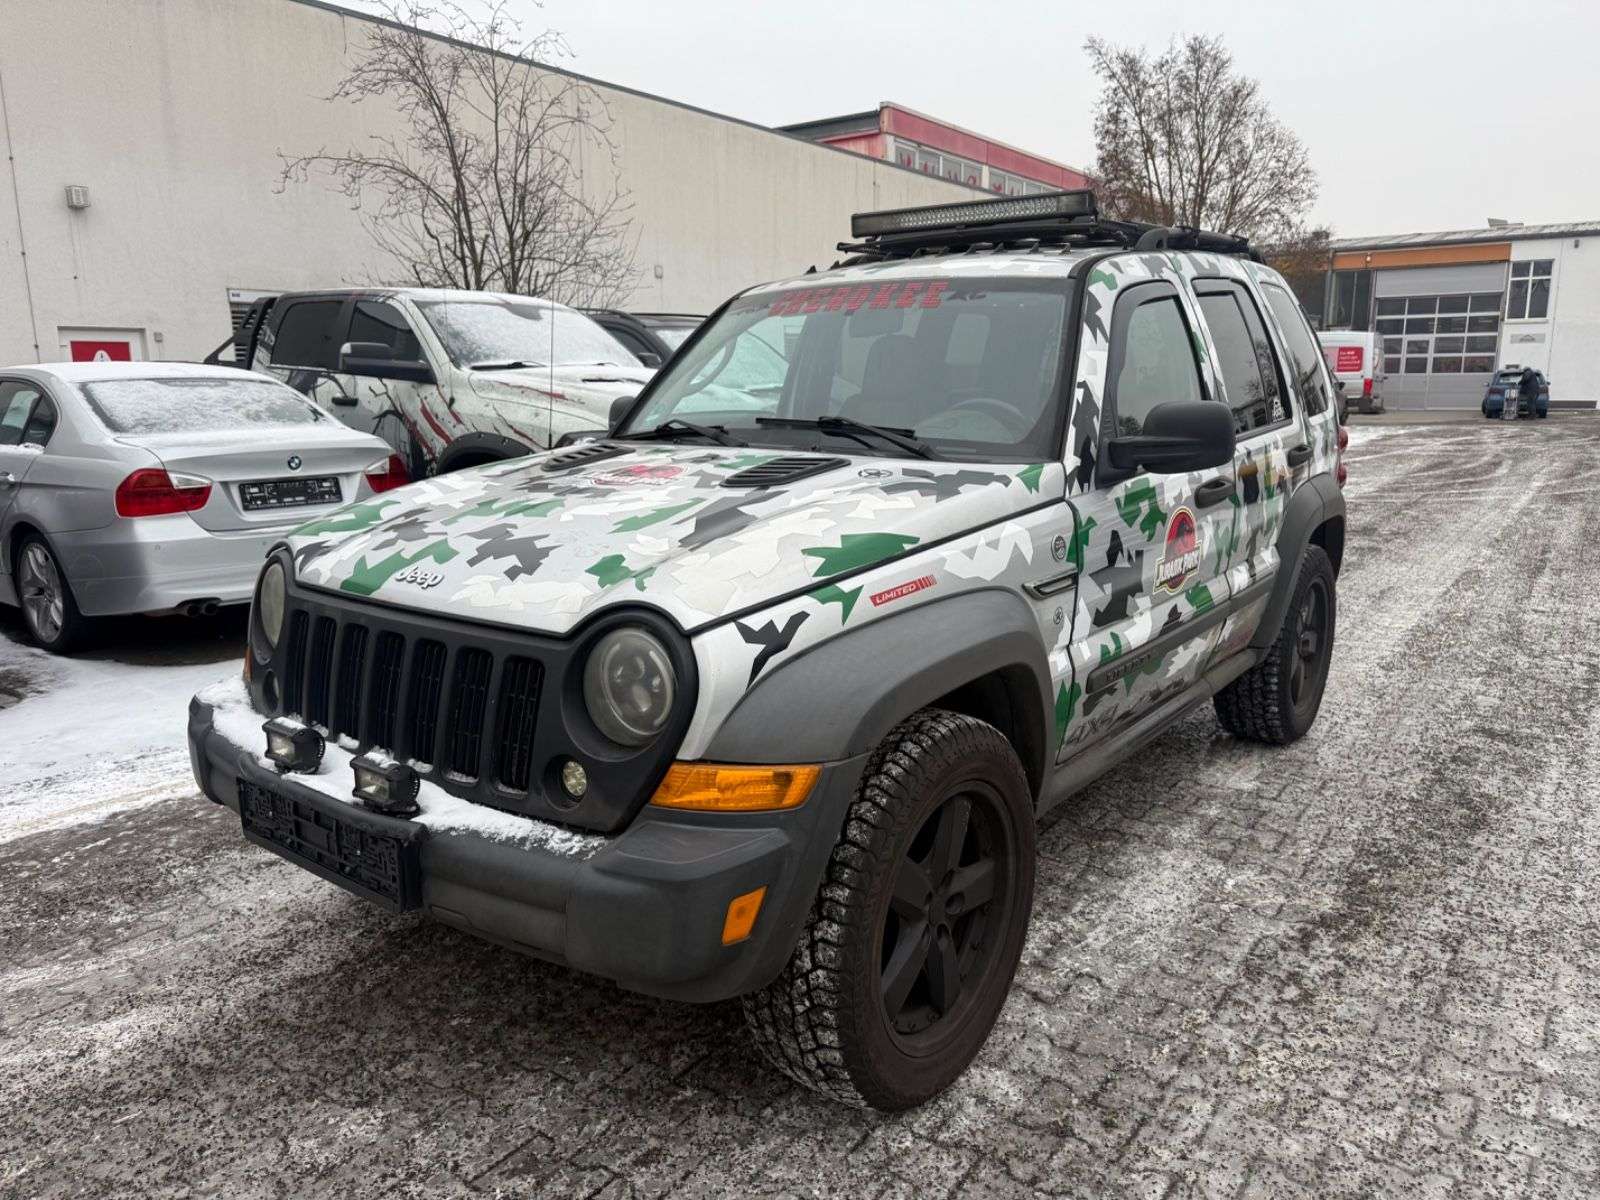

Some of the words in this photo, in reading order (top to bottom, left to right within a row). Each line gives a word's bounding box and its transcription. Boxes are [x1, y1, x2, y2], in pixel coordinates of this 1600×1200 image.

[768, 281, 949, 317] CHEROKEE
[394, 565, 445, 590] Jeep
[875, 583, 917, 604] LIMITED
